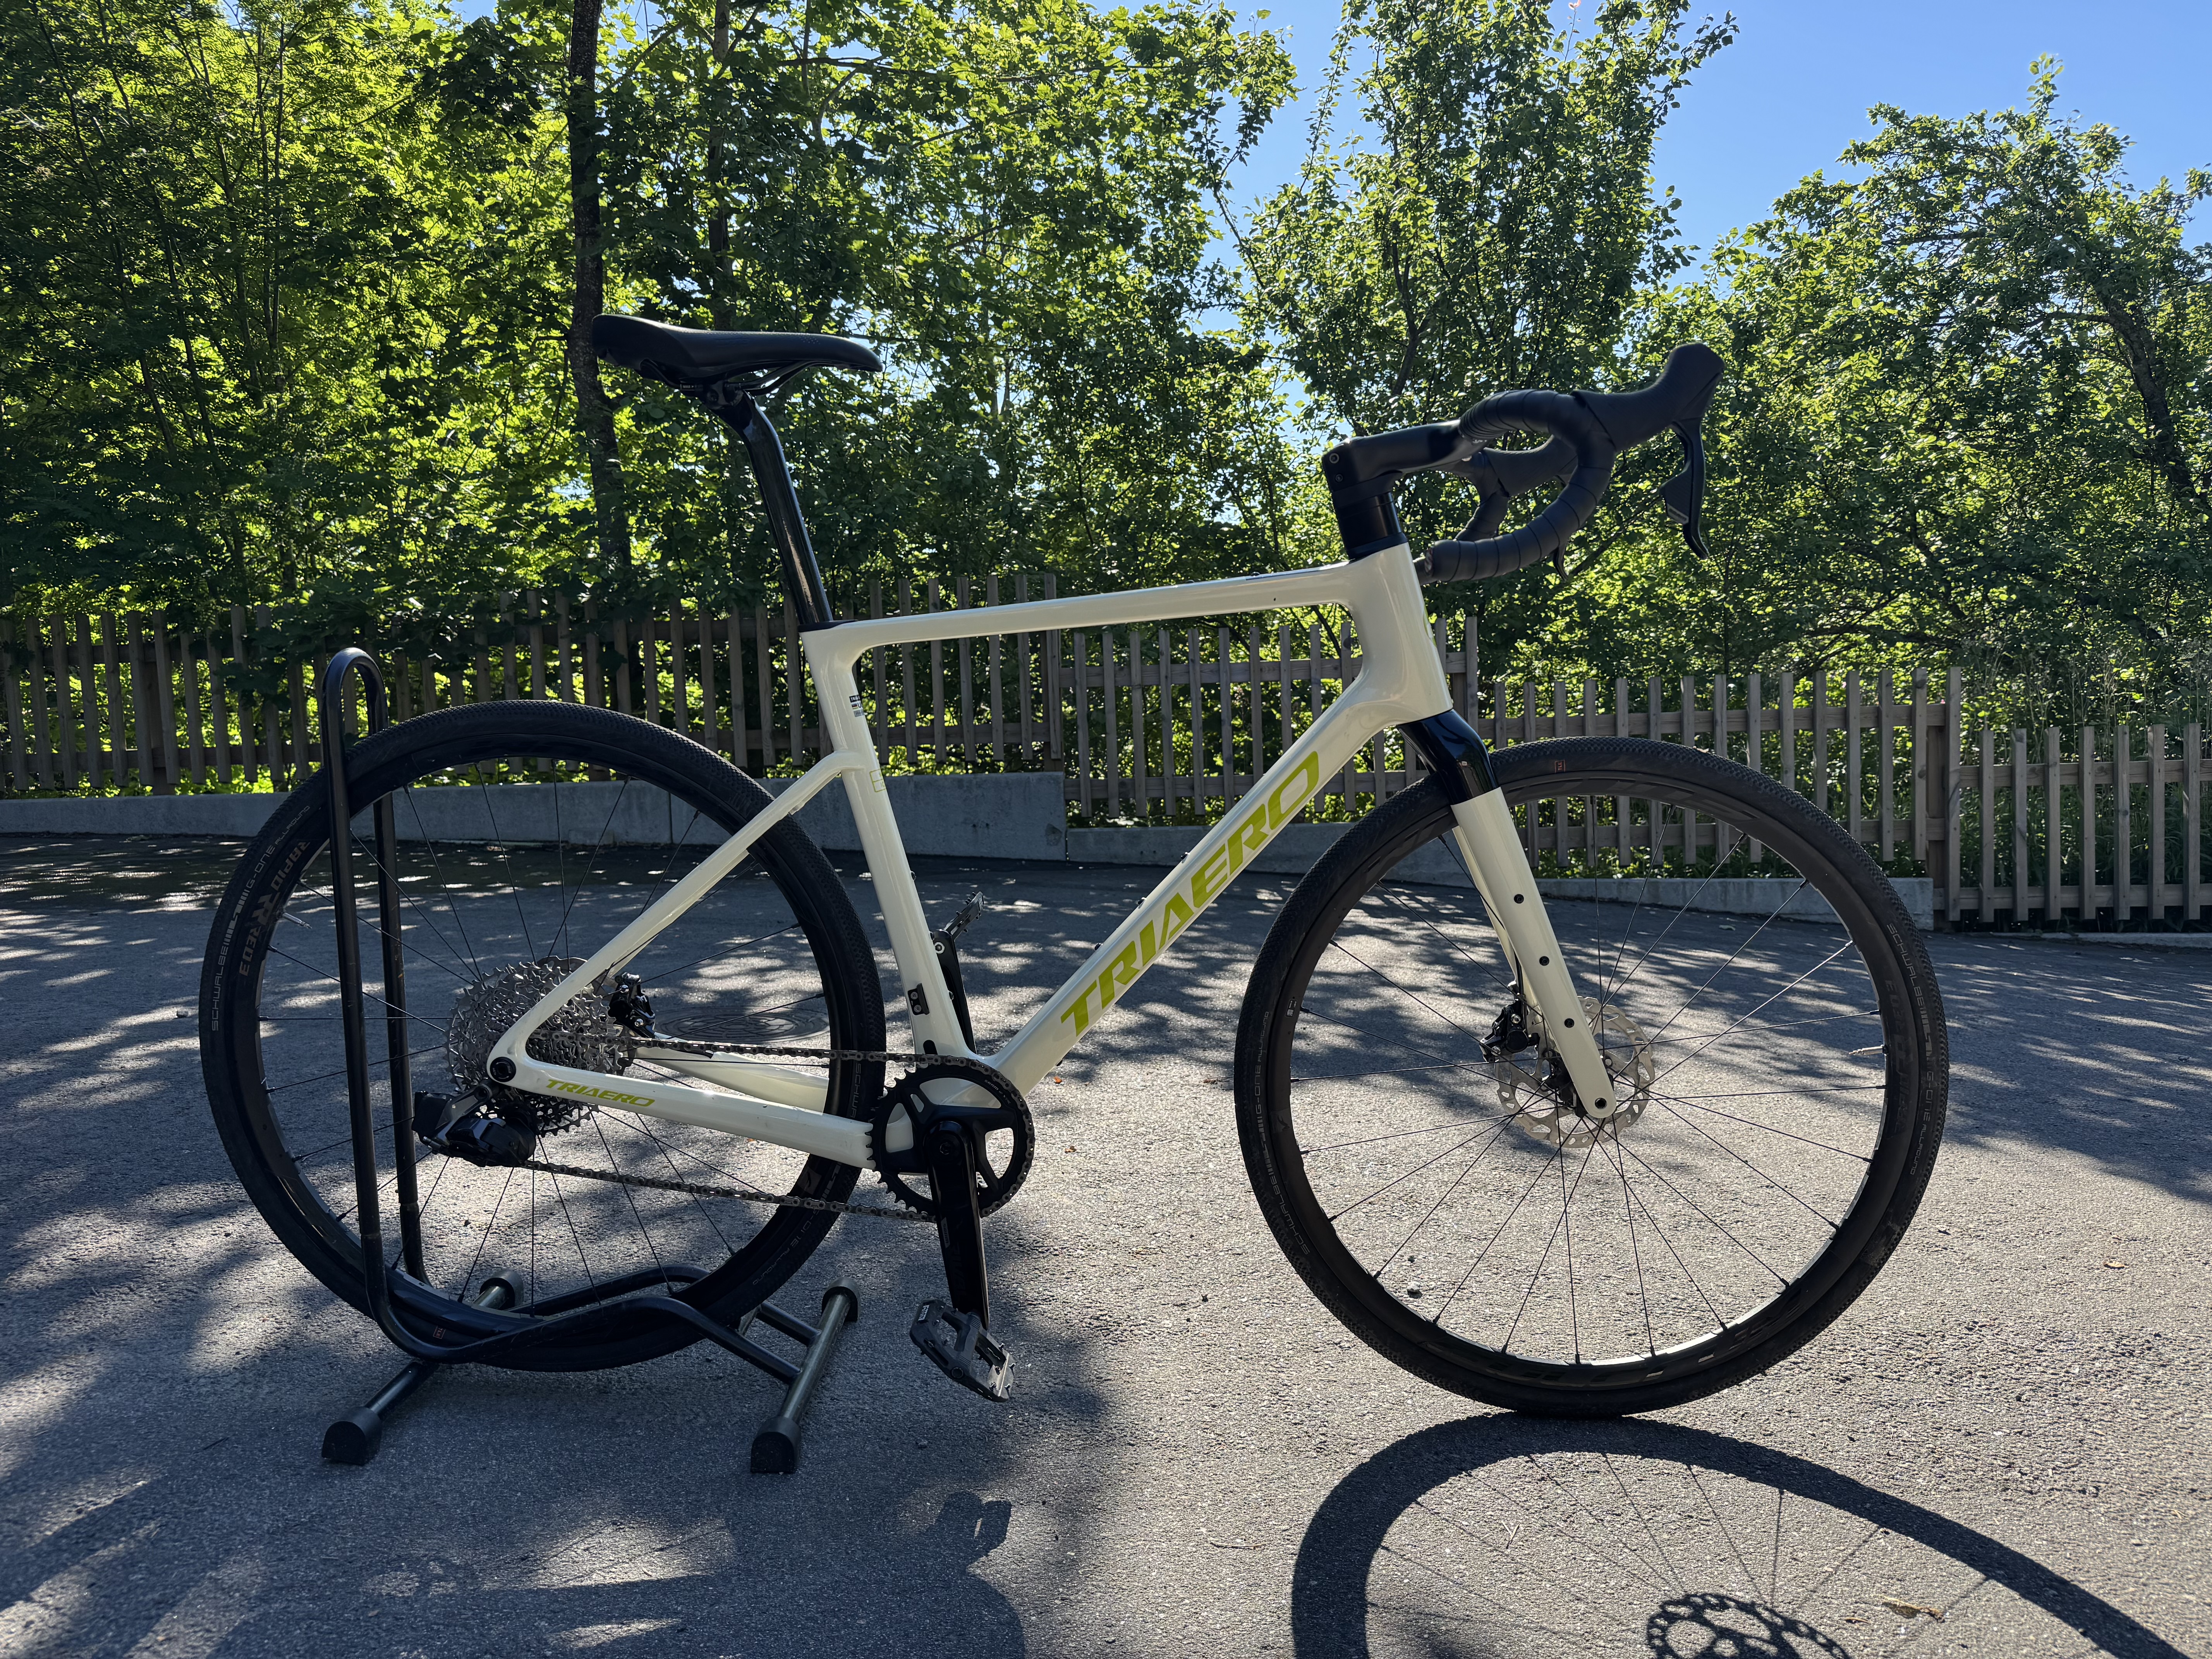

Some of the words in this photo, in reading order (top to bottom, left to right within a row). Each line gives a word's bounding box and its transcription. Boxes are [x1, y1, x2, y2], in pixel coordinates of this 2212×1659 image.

[272, 842, 310, 891] RAPID
[211, 946, 228, 1031] SCHWALBE
[246, 845, 275, 889] G-ONE
[275, 805, 311, 845] ALLROUND
[1061, 750, 1319, 1037] TRIAERO
[239, 960, 250, 977] 3
[242, 926, 261, 962] RED
[1886, 922, 1924, 1007] SCHWALBE
[1257, 1011, 1269, 1062] ALLROUND
[546, 1079, 655, 1107] TRIAERO
[850, 1063, 861, 1118] SCHWA
[1923, 1071, 1934, 1121] G-ONE
[1910, 1123, 1931, 1175] ALLROUND
[1270, 1176, 1310, 1256] SCHWALBE
